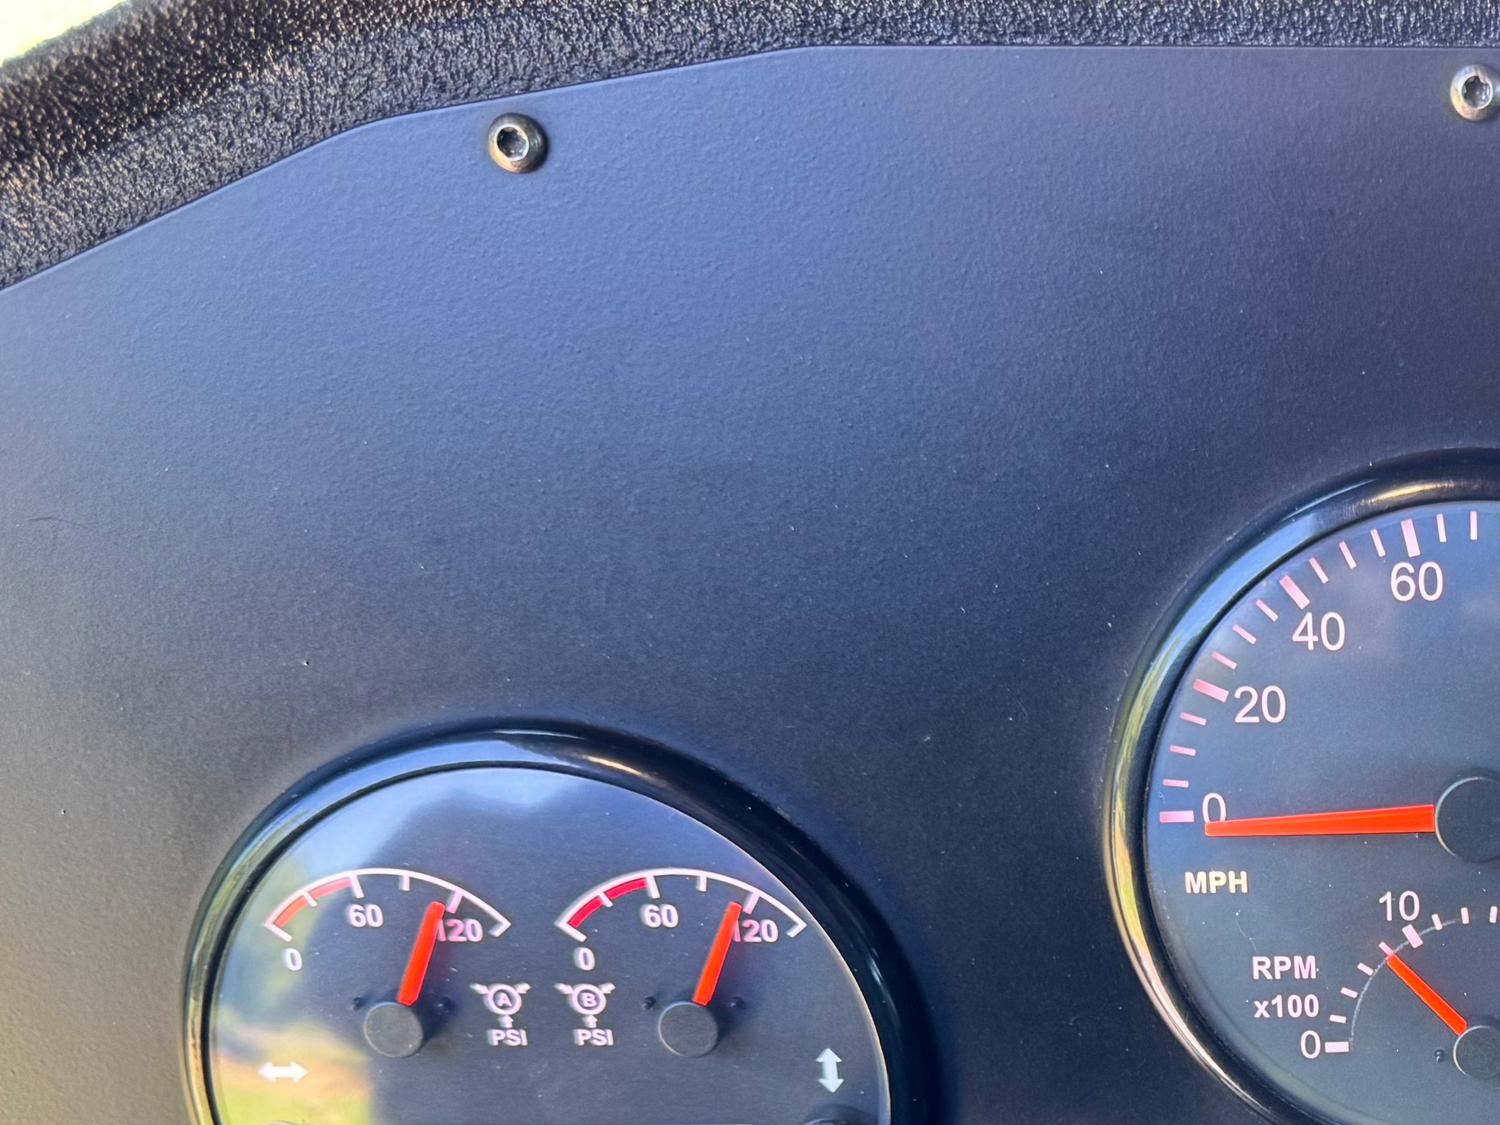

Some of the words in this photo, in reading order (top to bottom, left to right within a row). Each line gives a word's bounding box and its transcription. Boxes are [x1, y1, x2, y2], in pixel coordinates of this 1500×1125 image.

[1389, 561, 1443, 602] 60
[1292, 611, 1345, 651] 40
[1234, 685, 1287, 724] 20
[1202, 792, 1227, 824] 0
[1184, 871, 1249, 895] MPH
[346, 904, 384, 928] 60
[640, 904, 679, 928] 60
[1378, 890, 1421, 922] 10
[283, 948, 303, 972] 0
[574, 947, 595, 972] 0
[1252, 956, 1317, 981] RPM
[1253, 995, 1320, 1019] x100
[487, 1029, 529, 1046] PSI
[573, 1029, 614, 1046] PSI
[1300, 1030, 1321, 1059] 0
